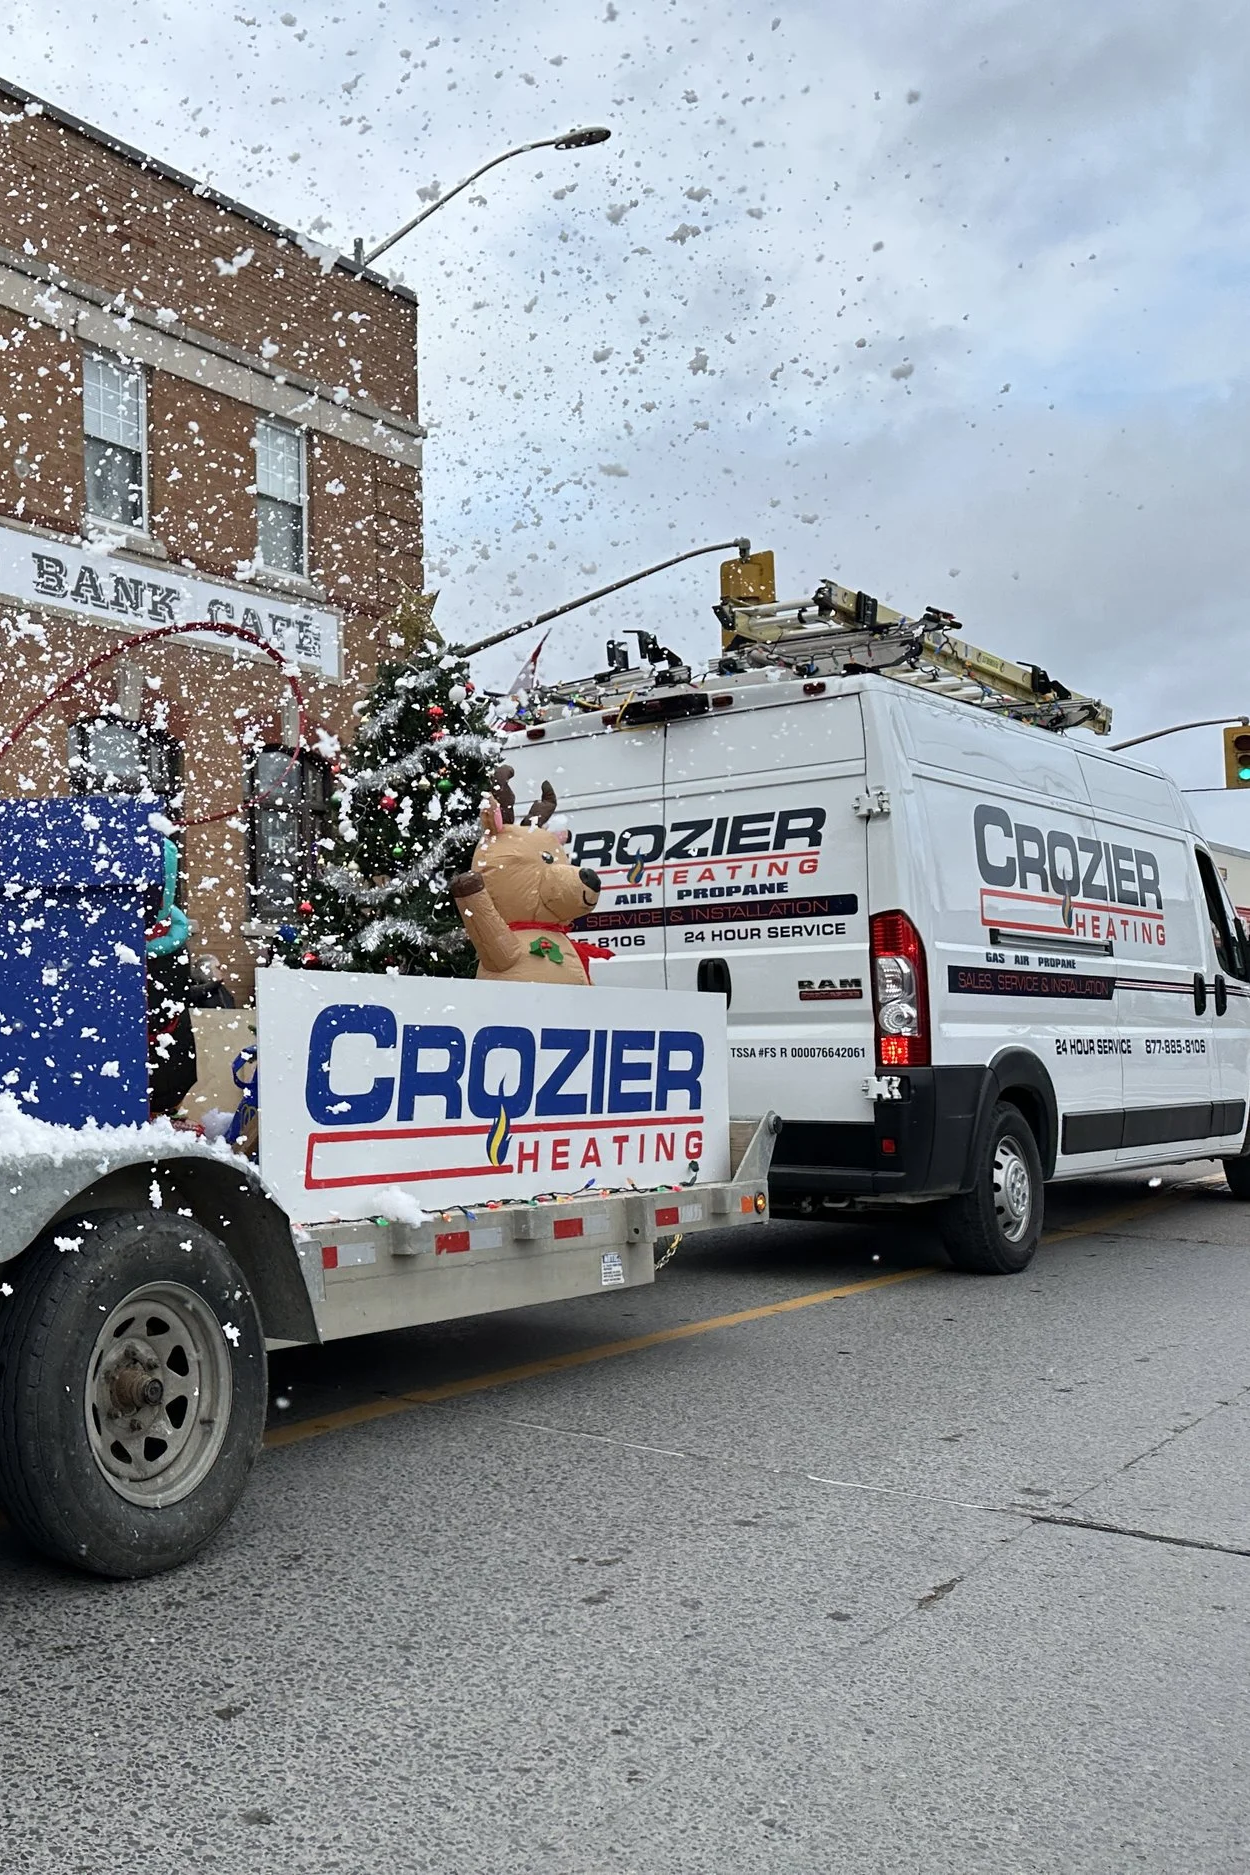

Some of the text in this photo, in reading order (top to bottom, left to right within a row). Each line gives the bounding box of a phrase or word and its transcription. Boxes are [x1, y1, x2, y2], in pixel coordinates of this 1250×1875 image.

[31, 552, 181, 623] BANK
[566, 807, 827, 867] ROZIER
[973, 803, 1164, 910] CROZIER
[645, 858, 820, 887] HEATING
[615, 882, 789, 906] AIR PROPANE
[586, 911, 663, 928] SERVICE
[669, 909, 685, 923] &
[691, 899, 829, 921] INSTALLATION
[684, 923, 847, 943] 24 HOUR SERVICE
[1074, 913, 1166, 946] HEATING
[985, 951, 1077, 969] GAS AIR PROPANE
[797, 978, 863, 990] RAM
[958, 971, 1109, 995] SALES, SERVICE & INSTALLATION
[730, 1047, 866, 1058] TSSA #FS R 000076642061
[1055, 1039, 1207, 1055] 24 HOUR SERVICE 877-885-8106
[305, 1003, 705, 1126] CROZIER
[517, 1130, 704, 1175] HEATING
